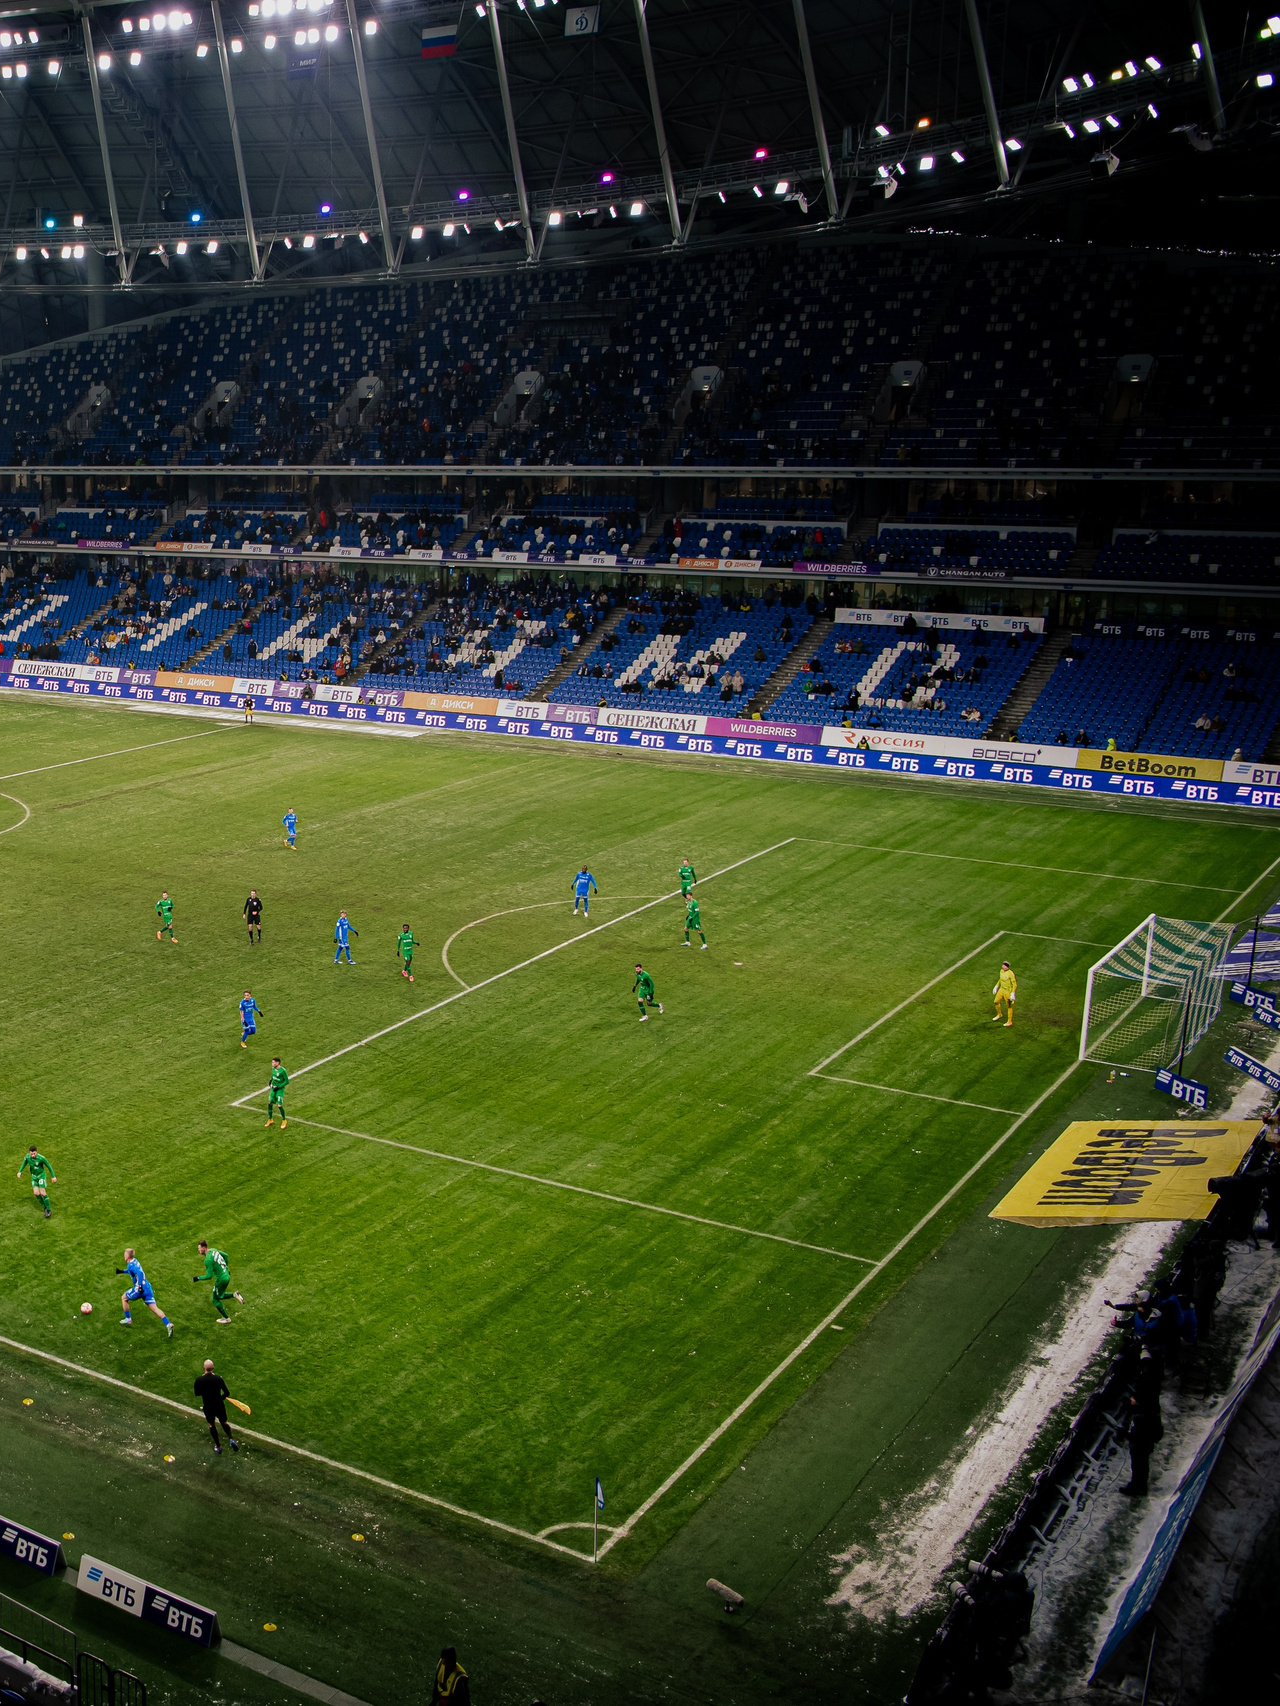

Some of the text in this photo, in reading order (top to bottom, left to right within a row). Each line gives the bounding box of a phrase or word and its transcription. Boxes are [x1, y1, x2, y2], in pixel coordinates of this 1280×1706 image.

[86, 541, 123, 549] WILDBERRIES
[807, 563, 867, 573] WILDBERRIES
[940, 569, 981, 577] CHANGAN
[856, 613, 871, 621] ВТБ
[971, 619, 988, 627] ВТБ
[1102, 626, 1255, 641] ВТБ ВТБ ВТБ ВТБ
[17, 663, 76, 678] СЕНЕЖСКАЯ
[95, 670, 113, 681] ВТБ
[132, 673, 151, 684] ВТБ
[187, 678, 214, 687] ДИКСИ
[248, 683, 267, 694] ВТБ
[332, 689, 353, 701] ВТБ
[376, 693, 398, 706] ВТБ
[442, 698, 473, 710] ДИКСИ
[515, 706, 540, 719] ВТБ
[565, 710, 590, 724] ВТБ
[607, 713, 697, 732] СЕНЕЖСКАЯ
[731, 723, 797, 738] WILDBERRIES
[14, 677, 29, 688] ВТБ
[43, 679, 59, 691] ВТБ
[73, 682, 89, 693] ВТБ
[105, 685, 121, 697] ВТБ
[136, 688, 153, 700] ВТБ
[170, 691, 187, 703] ВТБ
[203, 694, 220, 706] ВТБ
[273, 701, 291, 712] ВТБ
[310, 704, 329, 716] ВТБ
[346, 707, 366, 719] ВТБ
[385, 711, 405, 723] ВТБ
[425, 714, 446, 726] ВТБ
[466, 718, 487, 730] ВТБ
[508, 722, 529, 734] ВТБ
[551, 726, 573, 739] ВТБ
[595, 730, 618, 743] ВТБ
[641, 734, 664, 747] ВТБ
[688, 739, 712, 752] ВТБ
[736, 743, 762, 756] ВТБ
[786, 748, 813, 761] ВТБ
[838, 753, 865, 766] ВТБ
[891, 757, 919, 771] ВТБ
[946, 762, 975, 777] ВТБ
[1004, 768, 1033, 782] ВТБ
[1062, 774, 1092, 788] ВТБ
[1123, 779, 1154, 794] ВТБ
[1186, 785, 1218, 800] ВТБ
[864, 735, 925, 749] РОССИЯ
[973, 749, 1036, 763] BOSCO
[1100, 755, 1196, 778] BetBoom
[1252, 770, 1280, 785] ВТ
[1244, 990, 1274, 1011] ВТБ
[1258, 1011, 1272, 1024] ВТБ
[1230, 1054, 1279, 1090] ВТБ ВТБ ВТБ
[1171, 1081, 1206, 1108] ВТБ
[1036, 1128, 1228, 1205] BetBoom
[17, 1538, 48, 1568] ВТБ
[102, 1577, 136, 1608] ВТБ
[166, 1607, 203, 1638] ВТБ
